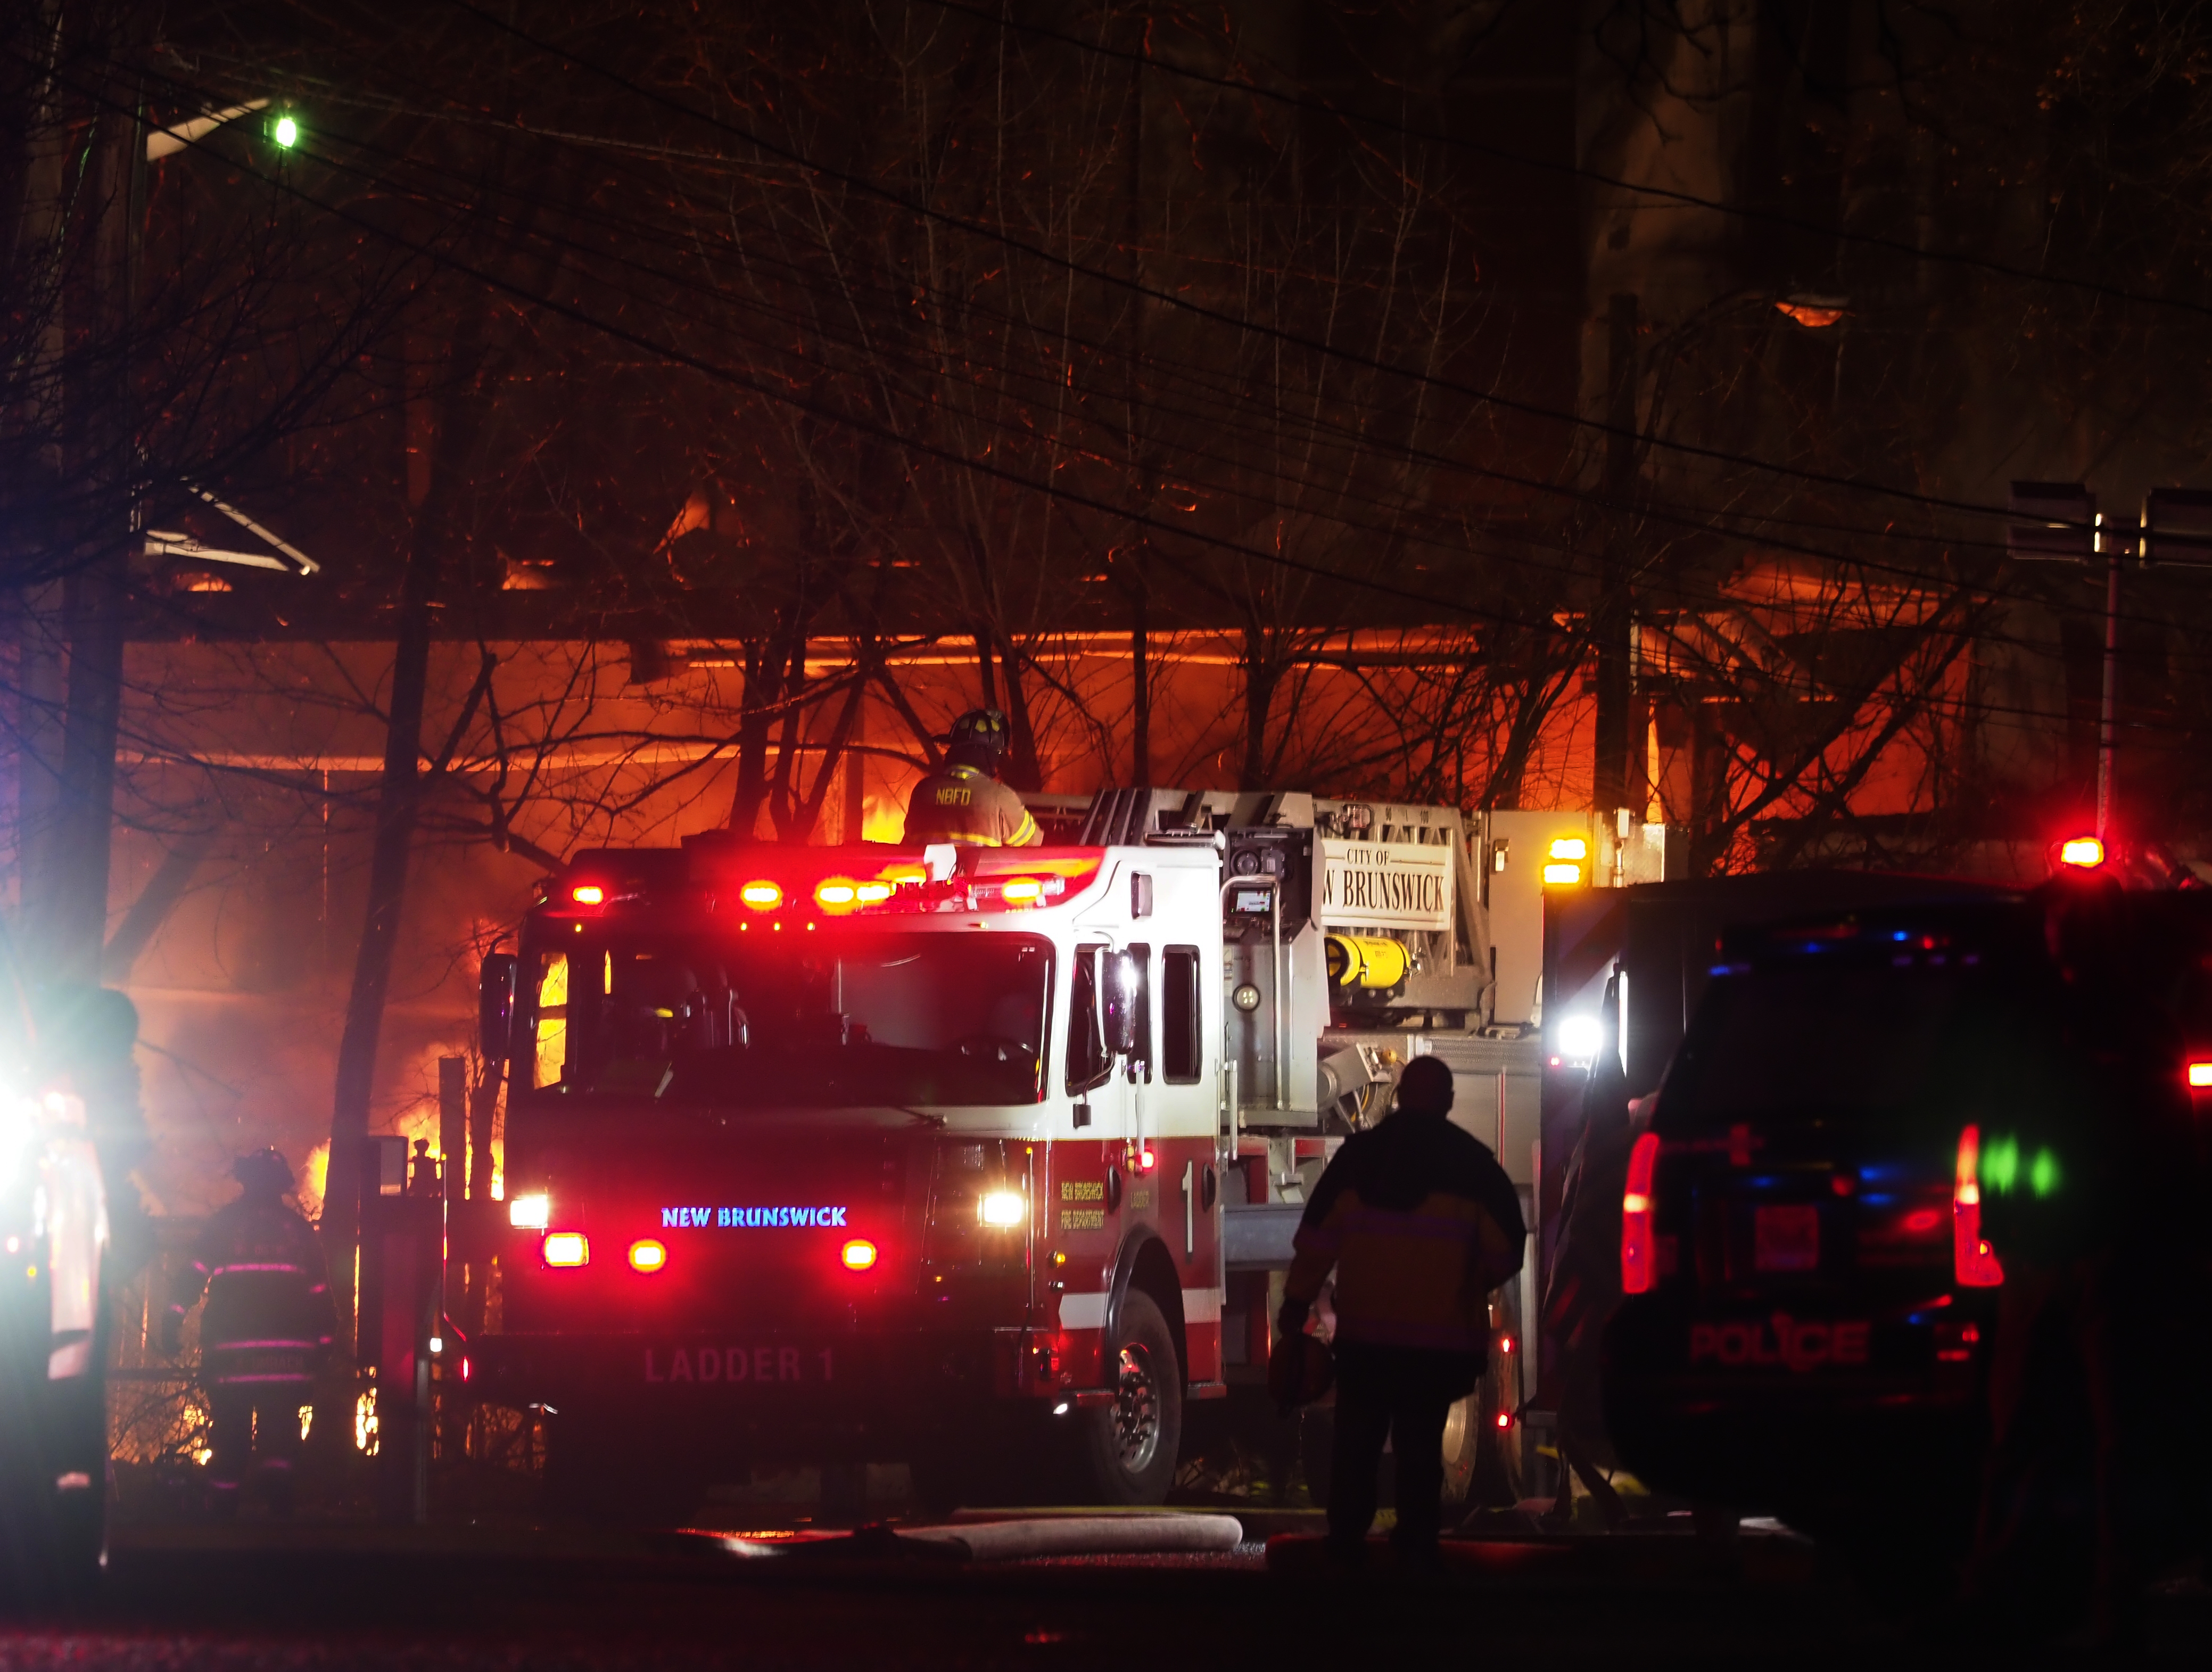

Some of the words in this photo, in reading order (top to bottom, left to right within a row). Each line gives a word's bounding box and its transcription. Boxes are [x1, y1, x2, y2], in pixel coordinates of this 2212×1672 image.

[936, 787, 971, 806] NBFD
[1347, 849, 1372, 864] CITY
[1376, 851, 1390, 866] OF
[1343, 870, 1445, 912] BRUNSWICK
[661, 1207, 712, 1228] NEW
[717, 1206, 847, 1227] BRUNSWICK
[1182, 1160, 1193, 1253] 1
[1690, 1311, 1871, 1370] POLICE
[645, 1348, 800, 1382] LADDER
[818, 1348, 832, 1381] 1
